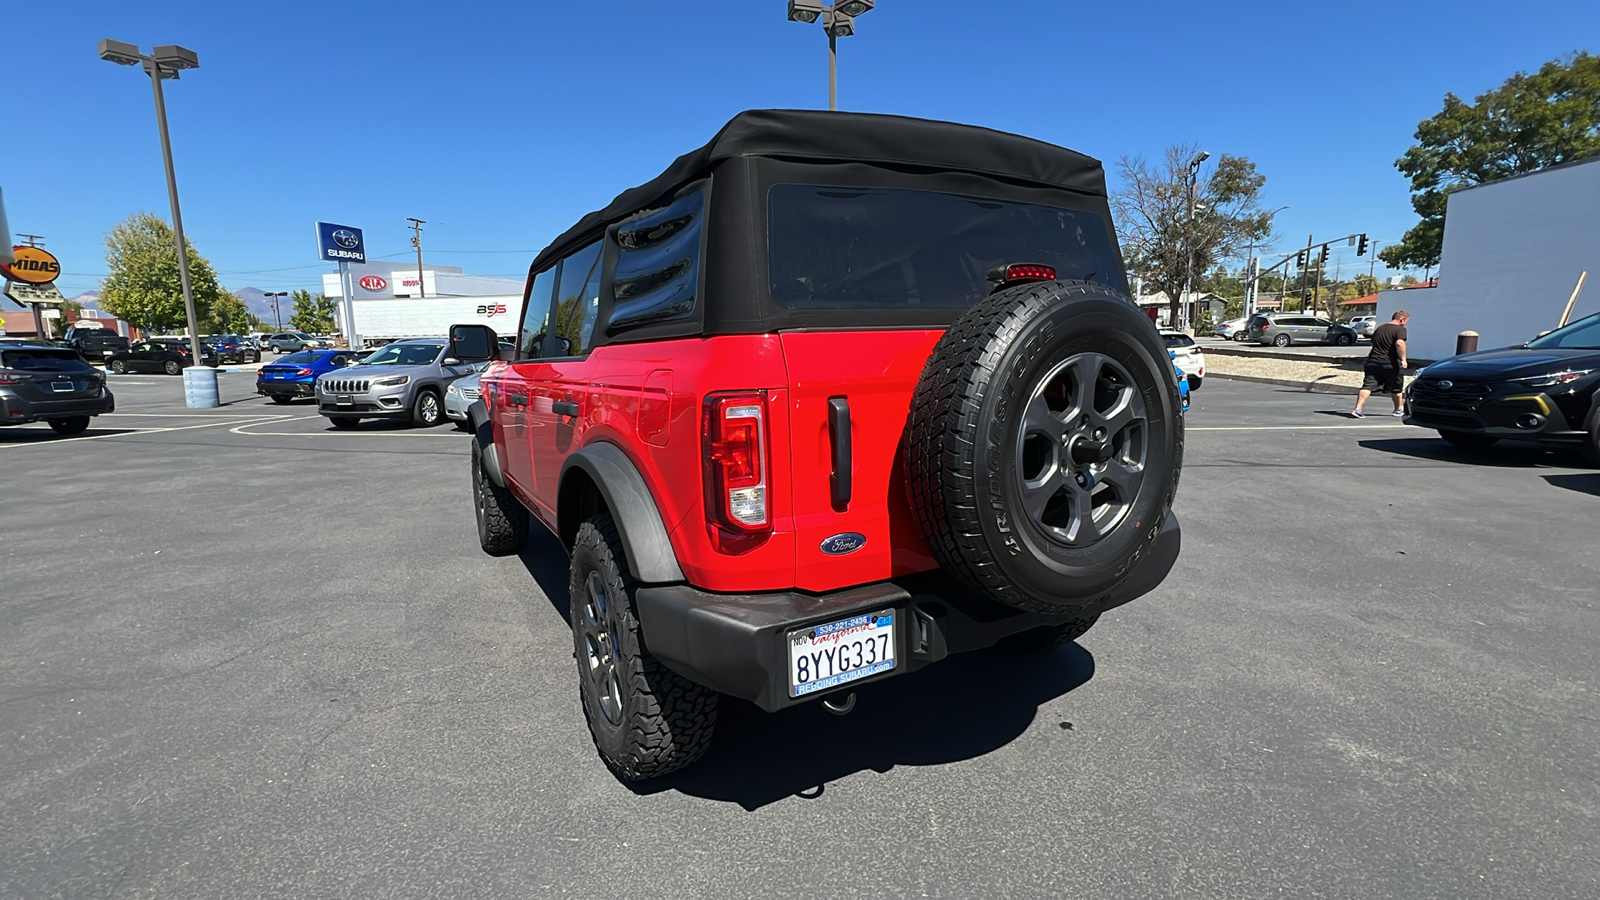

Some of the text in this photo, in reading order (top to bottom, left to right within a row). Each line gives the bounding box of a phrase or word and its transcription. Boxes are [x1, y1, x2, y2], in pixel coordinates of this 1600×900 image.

[327, 249, 363, 260] SUBARU
[9, 256, 58, 272] MIDAS
[361, 278, 385, 290] KIA
[985, 320, 1055, 556] BRIDGESTONE
[831, 537, 857, 552] Ford
[819, 616, 868, 635] 530-221-2436
[793, 635, 809, 647] NOV
[811, 623, 876, 646] California
[797, 633, 889, 684] 8YYG337
[799, 676, 838, 694] REDDING
